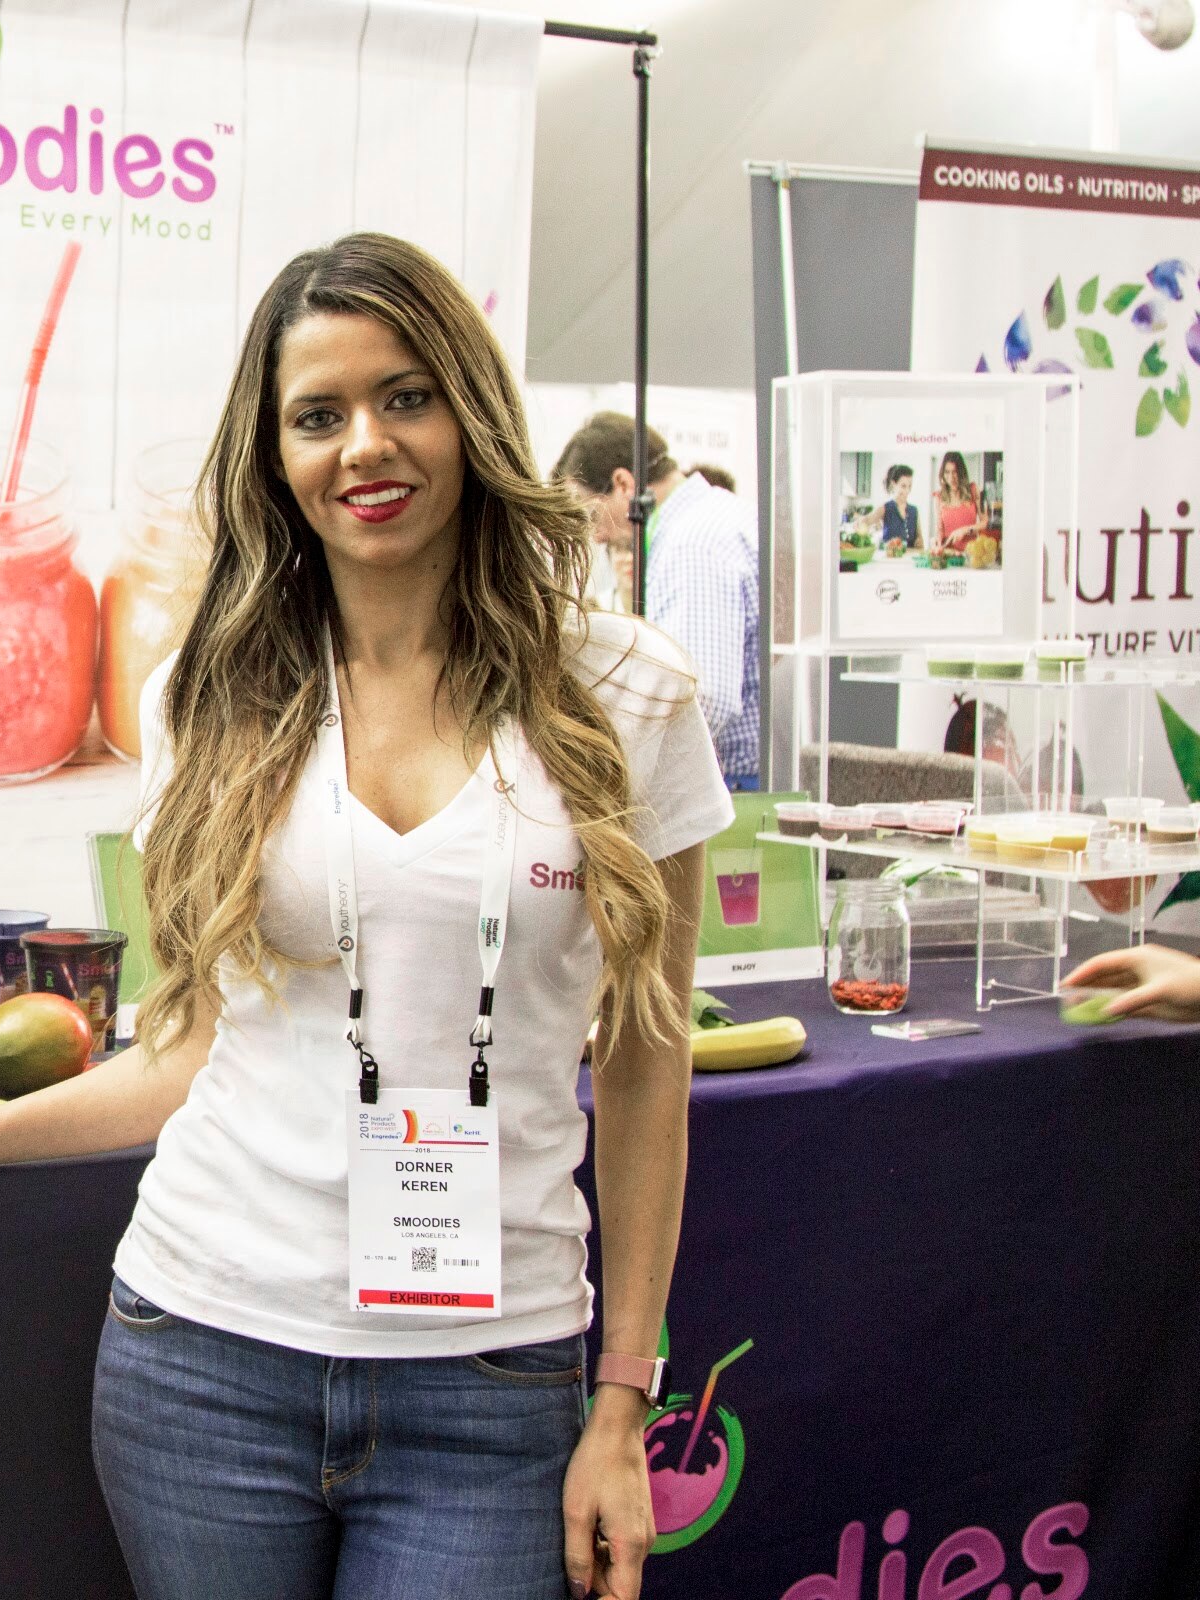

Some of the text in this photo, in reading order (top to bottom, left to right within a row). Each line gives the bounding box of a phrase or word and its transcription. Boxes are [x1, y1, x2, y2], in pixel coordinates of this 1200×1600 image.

[934, 165, 1020, 191] COOKING
[1024, 173, 1064, 194] OILS
[1077, 176, 1168, 203] NUTRITION
[21, 204, 112, 238] Every
[131, 213, 213, 242] Mood
[731, 962, 756, 972] ENJOY
[360, 1113, 369, 1139] 2018
[395, 1161, 453, 1173] DORNER
[401, 1180, 448, 1192] KEREN
[393, 1217, 461, 1228] SMOODIES
[389, 1292, 461, 1306] EXHIBITOR
